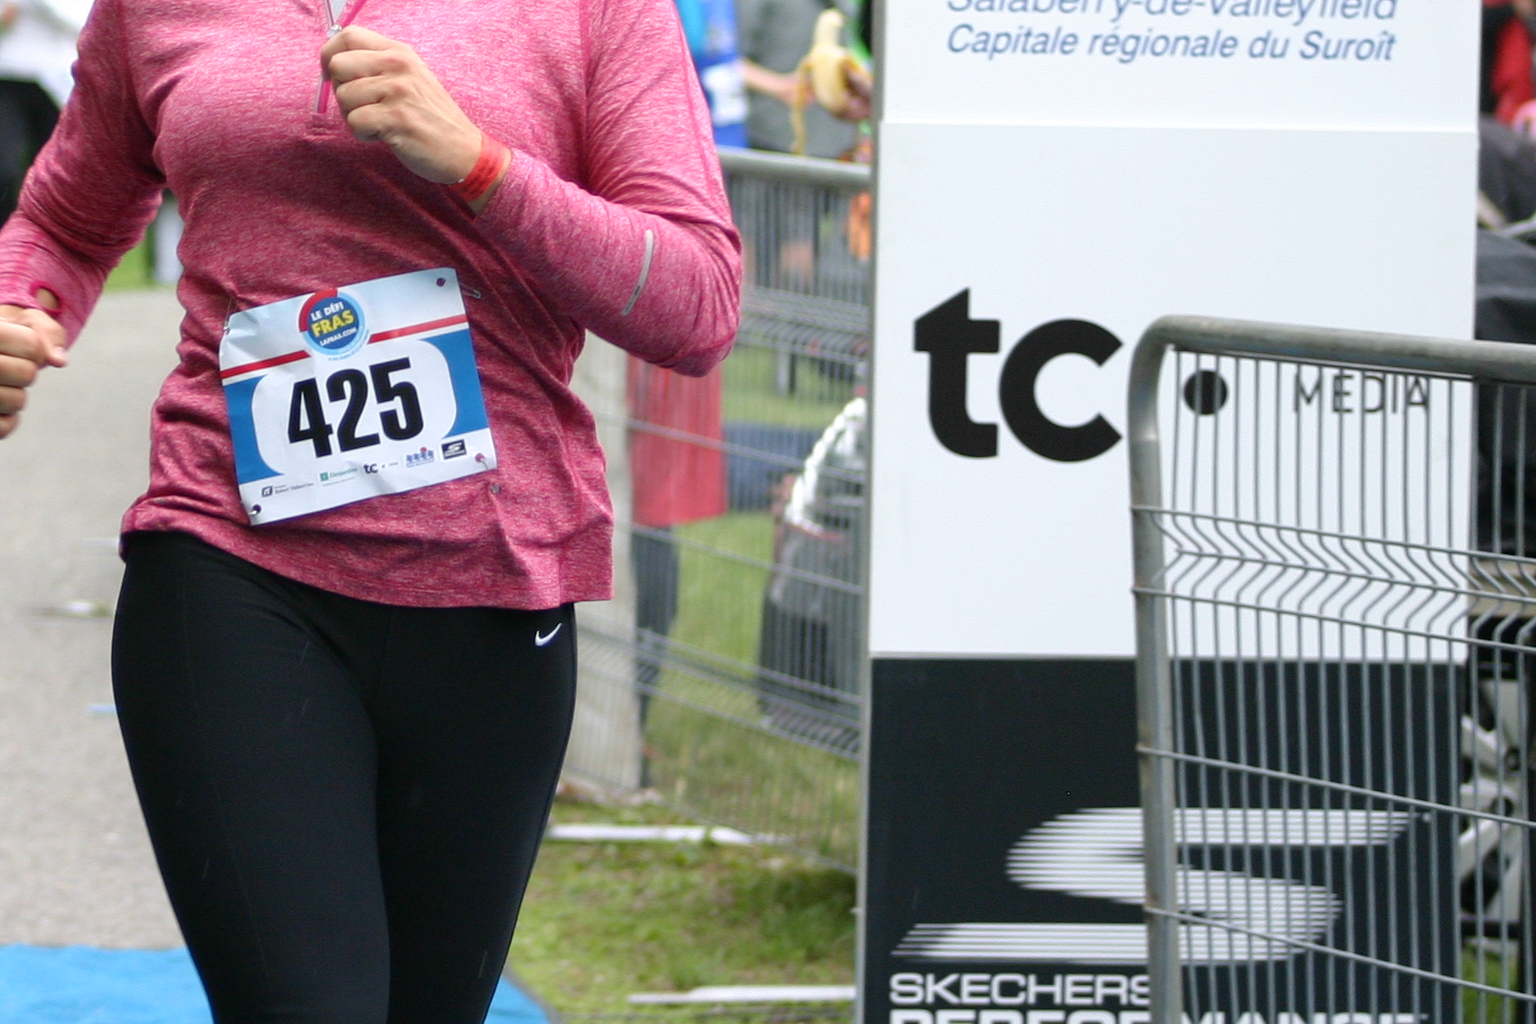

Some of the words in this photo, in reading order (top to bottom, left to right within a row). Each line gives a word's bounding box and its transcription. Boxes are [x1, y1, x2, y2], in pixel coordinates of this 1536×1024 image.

[946, 23, 1079, 61] Capitale
[1087, 25, 1239, 64] régionale
[1248, 29, 1290, 60] du
[1298, 29, 1398, 62] Suroît
[310, 310, 323, 321] LE
[323, 301, 344, 316] DÉFI
[311, 309, 355, 338] FRAS
[913, 287, 1124, 463] tc
[1294, 372, 1431, 414] MEDIA
[288, 357, 424, 458] 425
[889, 973, 1152, 1006] SKECHERS
